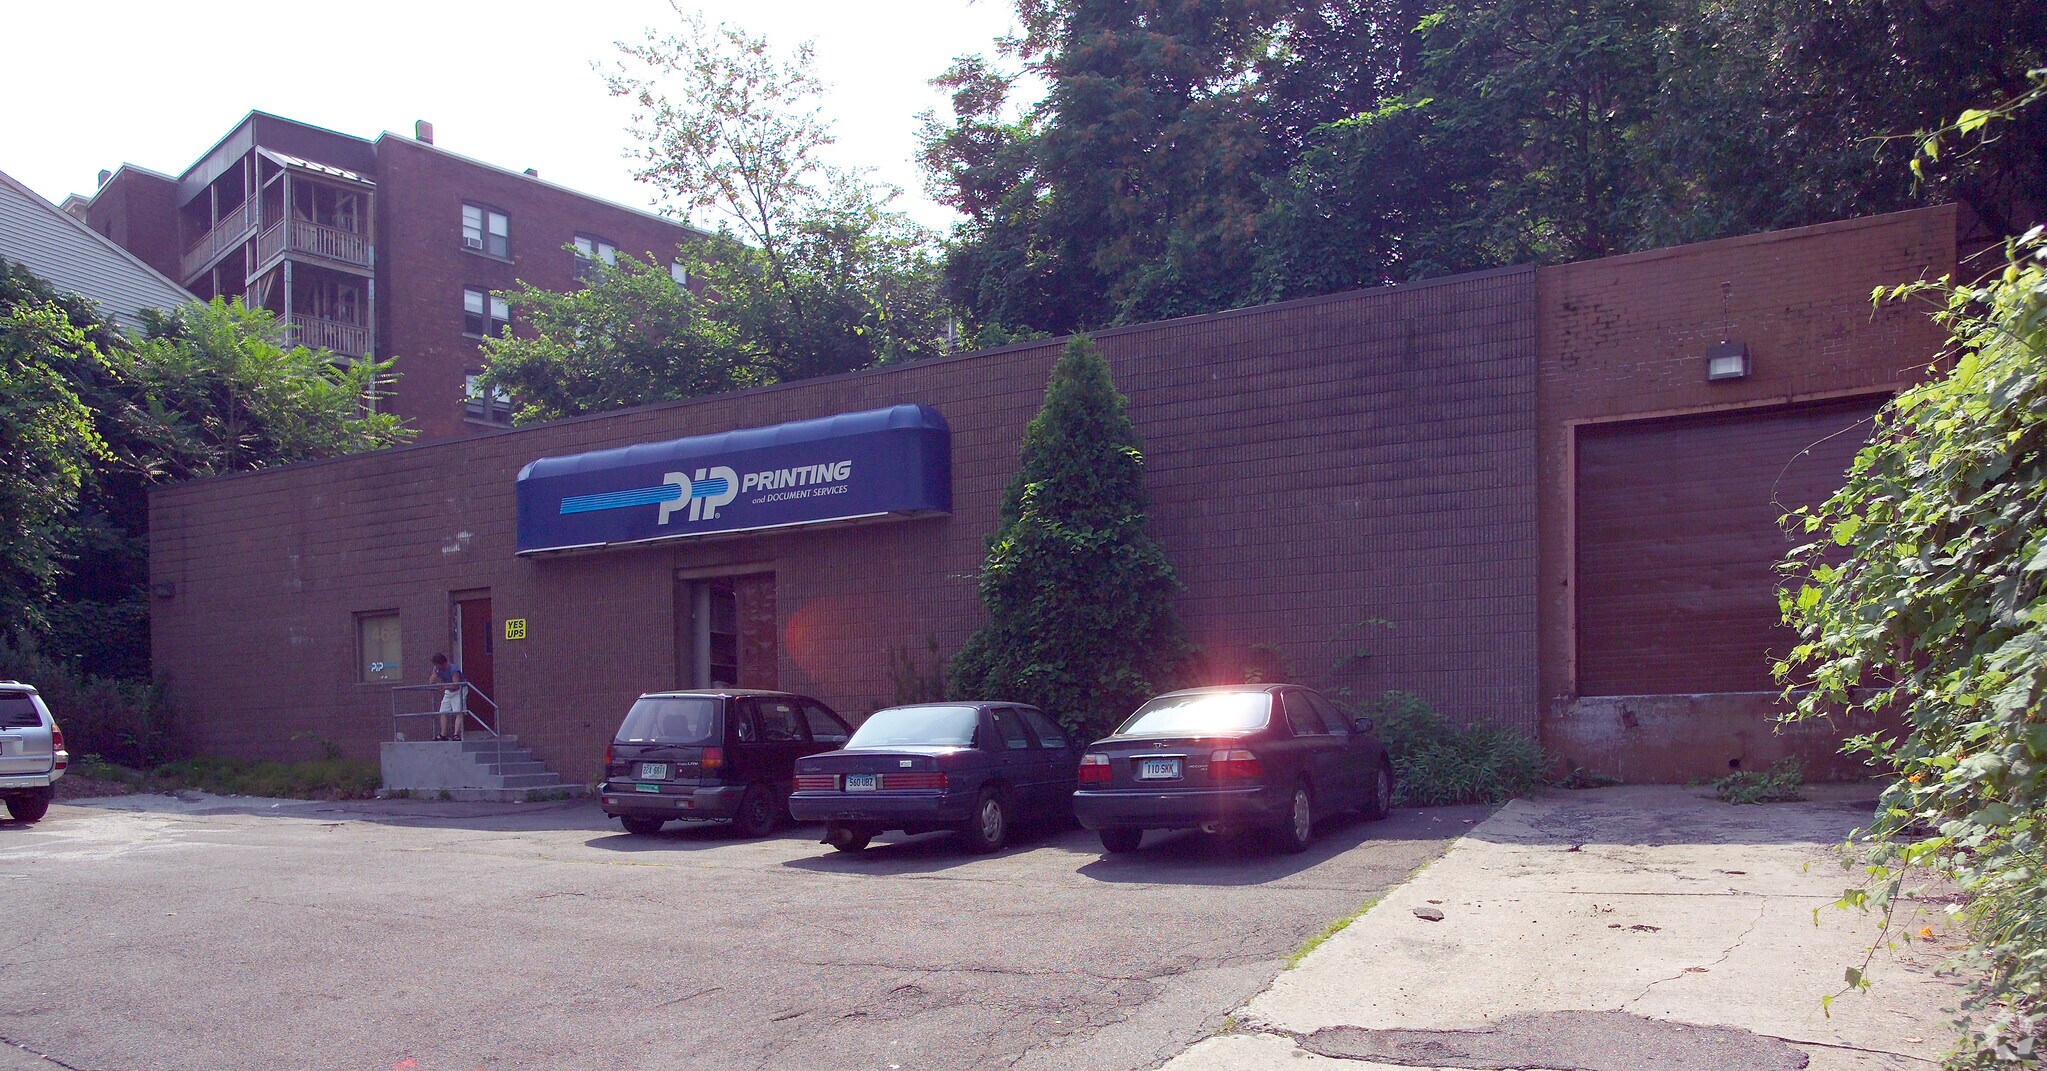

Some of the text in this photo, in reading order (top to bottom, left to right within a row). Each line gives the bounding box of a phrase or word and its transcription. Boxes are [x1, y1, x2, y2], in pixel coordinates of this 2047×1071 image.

[741, 460, 852, 493] PRINTING
[752, 485, 848, 504] and DOCUMENT SERVICES
[508, 620, 523, 629] YES
[507, 629, 524, 638] UPS
